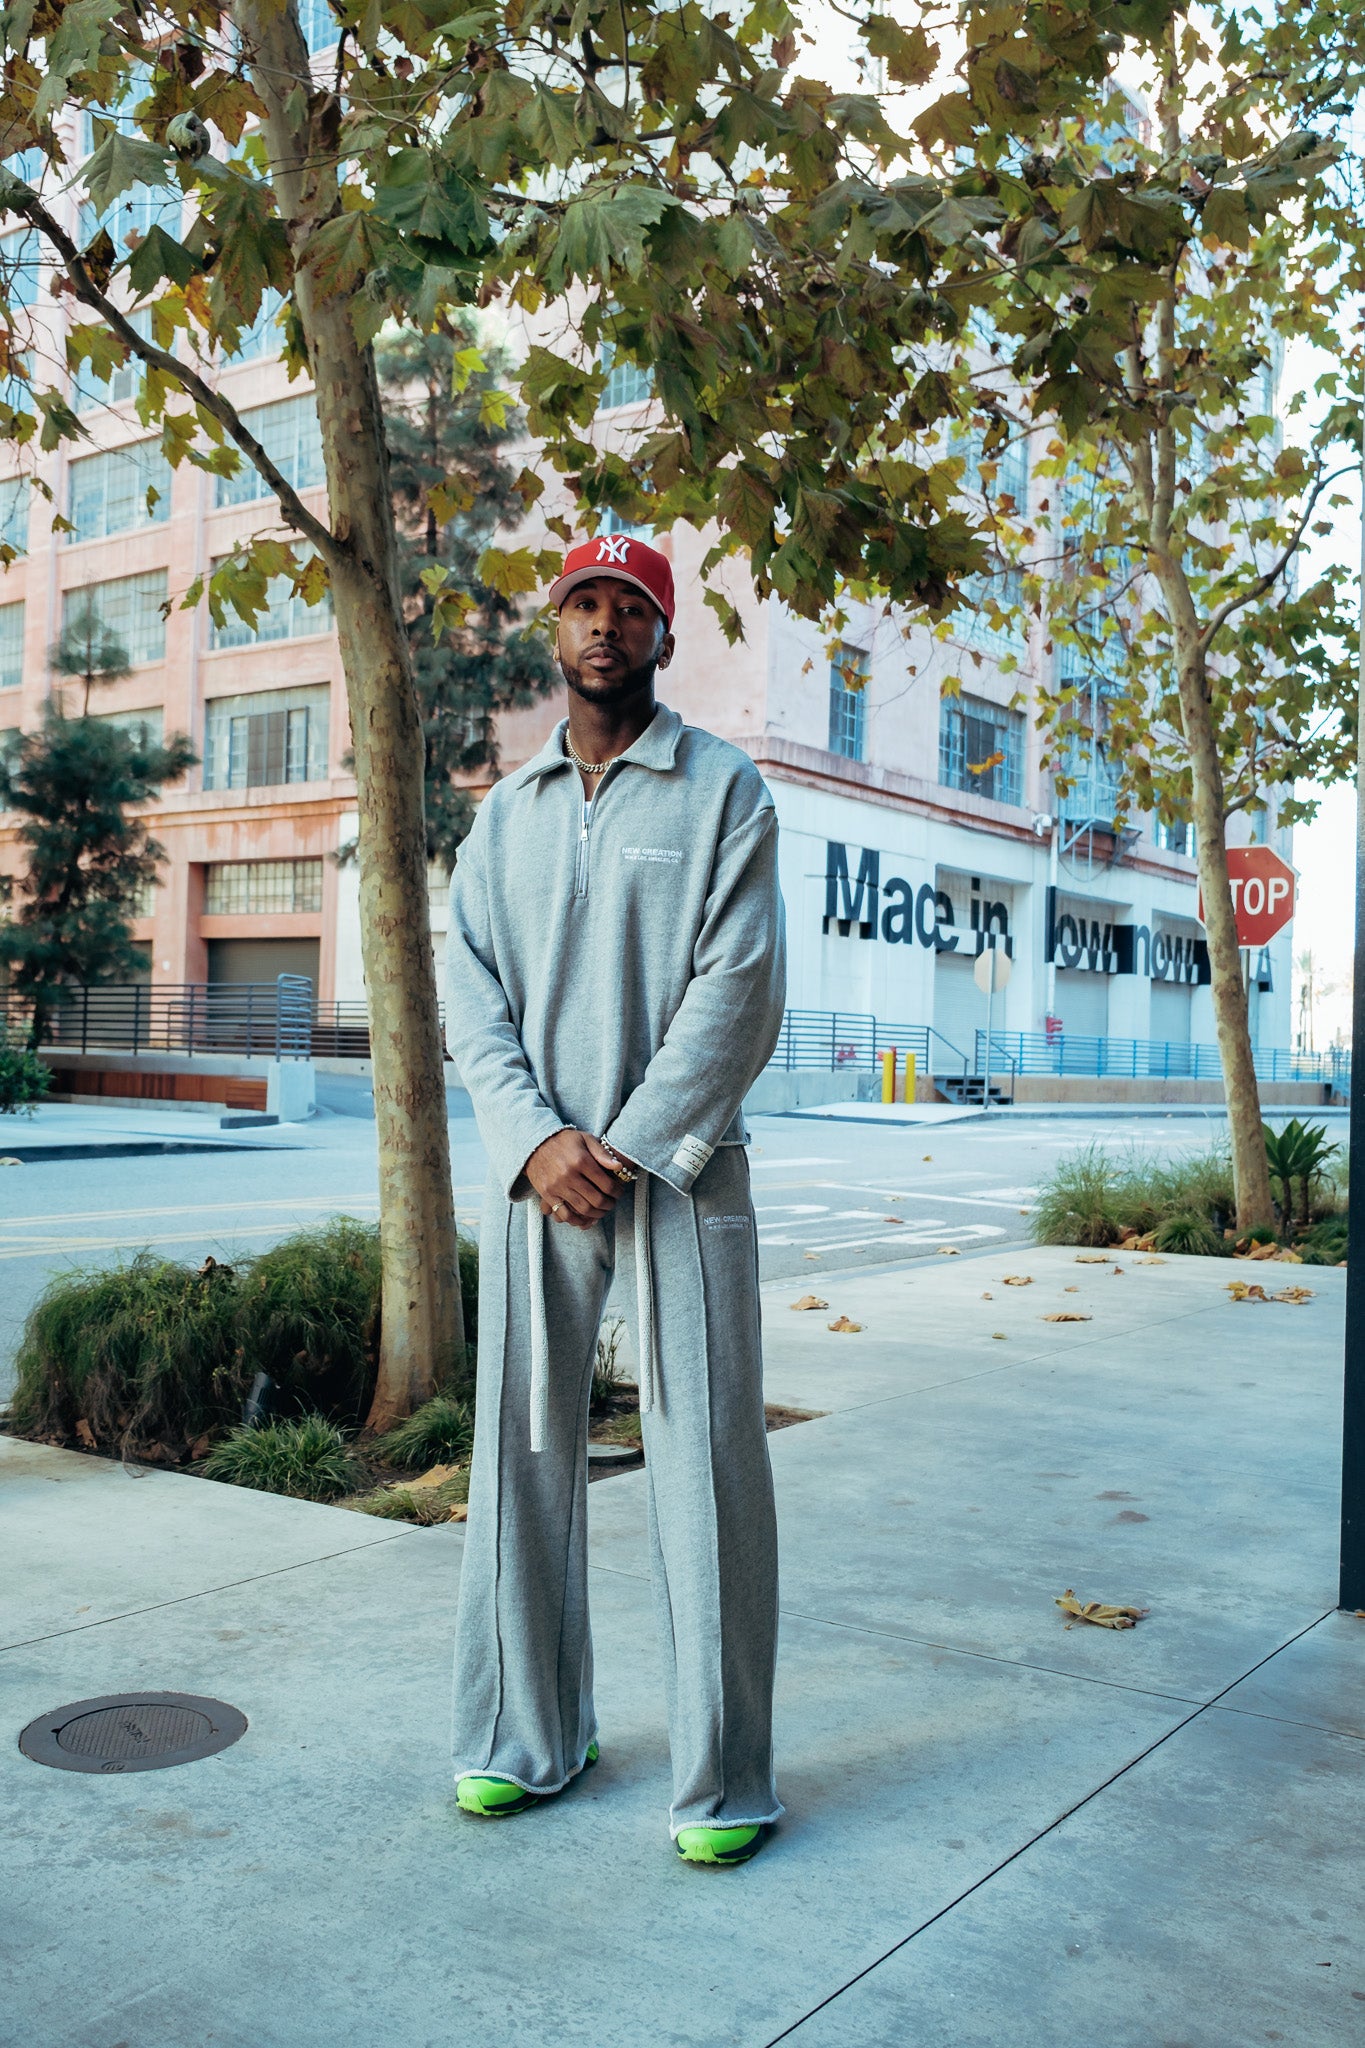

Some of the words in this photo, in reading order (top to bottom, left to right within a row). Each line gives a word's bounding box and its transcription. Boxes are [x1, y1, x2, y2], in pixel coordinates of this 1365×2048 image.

[596, 536, 630, 564] NY
[641, 848, 682, 858] CREATION
[1228, 877, 1290, 916] TOP
[703, 1216, 721, 1225] NEW
[757, 1204, 1008, 1252] TOP
